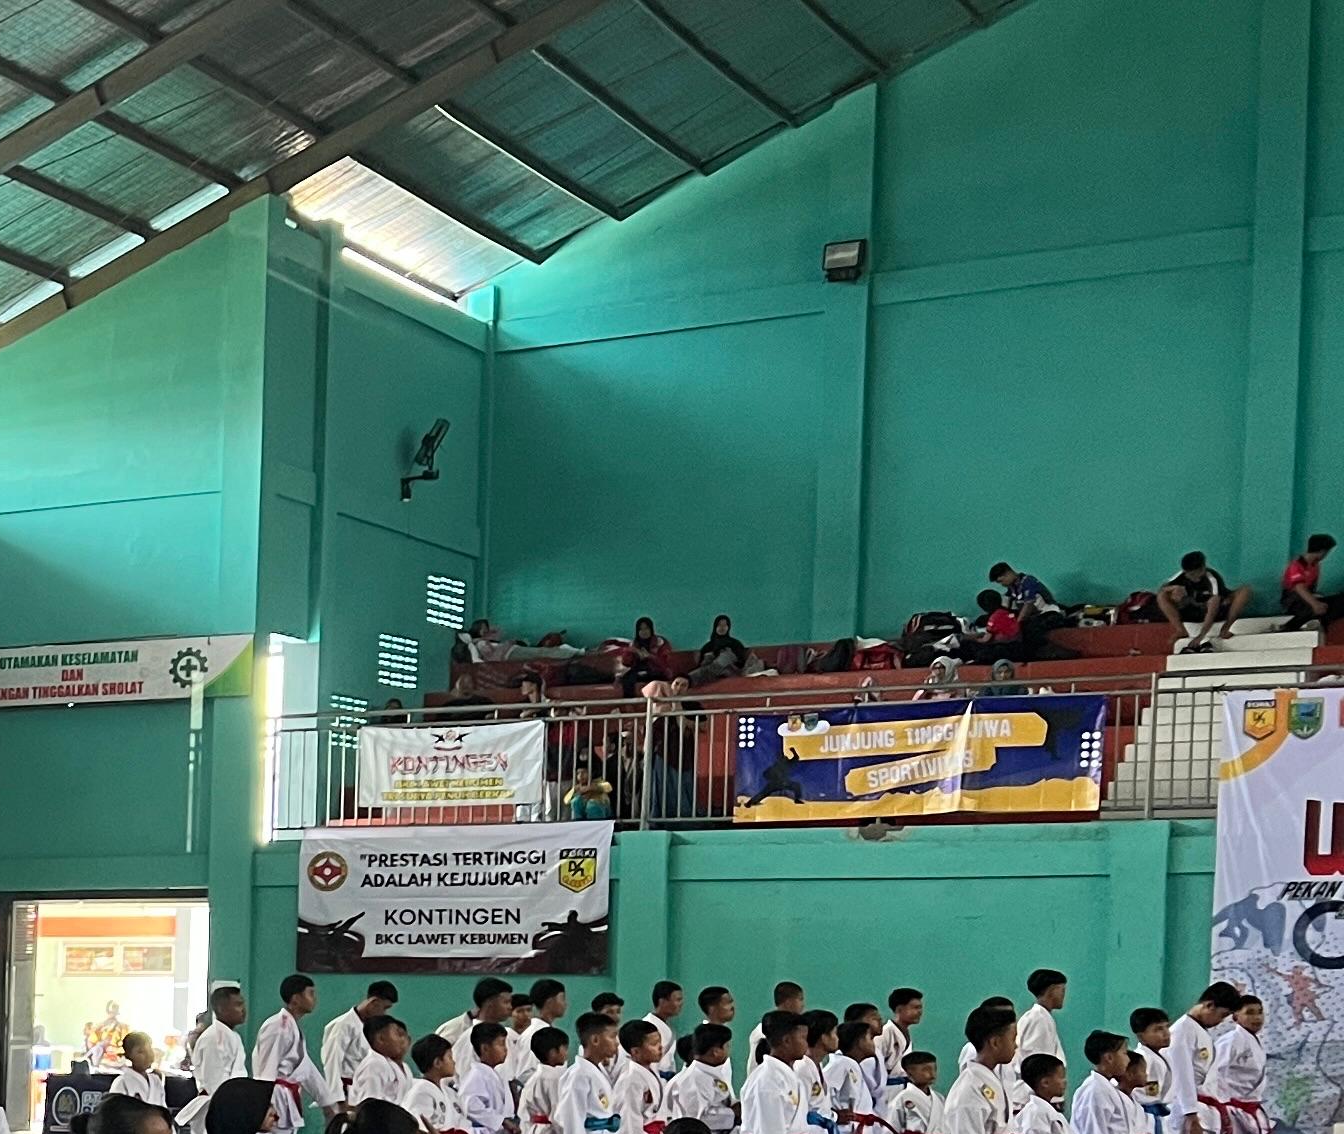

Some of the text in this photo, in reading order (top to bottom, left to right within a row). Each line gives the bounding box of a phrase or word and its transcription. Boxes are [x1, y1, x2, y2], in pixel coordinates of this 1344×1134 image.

[0, 649, 139, 670] UTAMAKAN KESELAMATAN
[62, 668, 84, 682] DAN
[32, 683, 99, 699] TINGGALKAN
[102, 680, 144, 695] SHOLAT
[820, 730, 895, 753] JUNJUNG
[968, 719, 1012, 738] JIWA
[389, 752, 508, 775] KONTINGEN
[867, 750, 974, 788] SPORTIVIS
[360, 850, 546, 868] "PRESTASI TERTINGGI
[361, 873, 432, 888] ADALAH
[437, 870, 547, 887] KEJUJURAN"
[1281, 881, 1343, 898] PEKAN
[384, 908, 521, 925] KONTINGEN
[375, 933, 528, 945] BKC LAWET KEBUMEN
